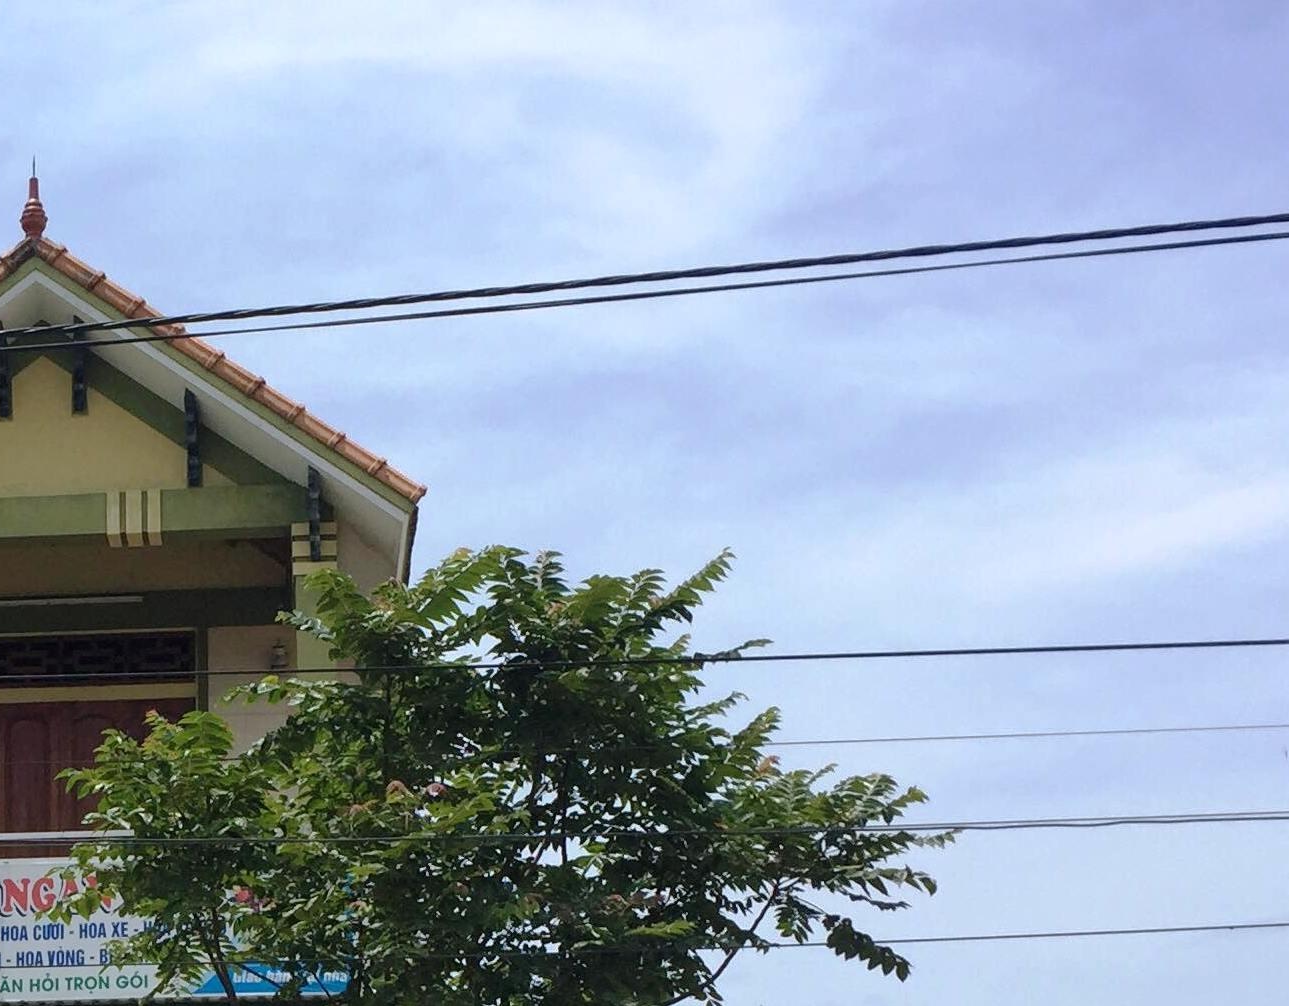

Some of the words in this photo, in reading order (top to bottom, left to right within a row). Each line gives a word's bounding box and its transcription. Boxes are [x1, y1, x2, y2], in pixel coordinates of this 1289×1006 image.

[0, 925, 29, 942] HOA
[79, 922, 107, 939] HOA
[112, 921, 129, 938] XE
[16, 951, 43, 967] HOA
[48, 946, 85, 966] VÒNG
[0, 976, 23, 993] ĂN
[29, 973, 59, 992] HỎI
[64, 975, 110, 994] TRỌN
[115, 971, 149, 989] GÓI
